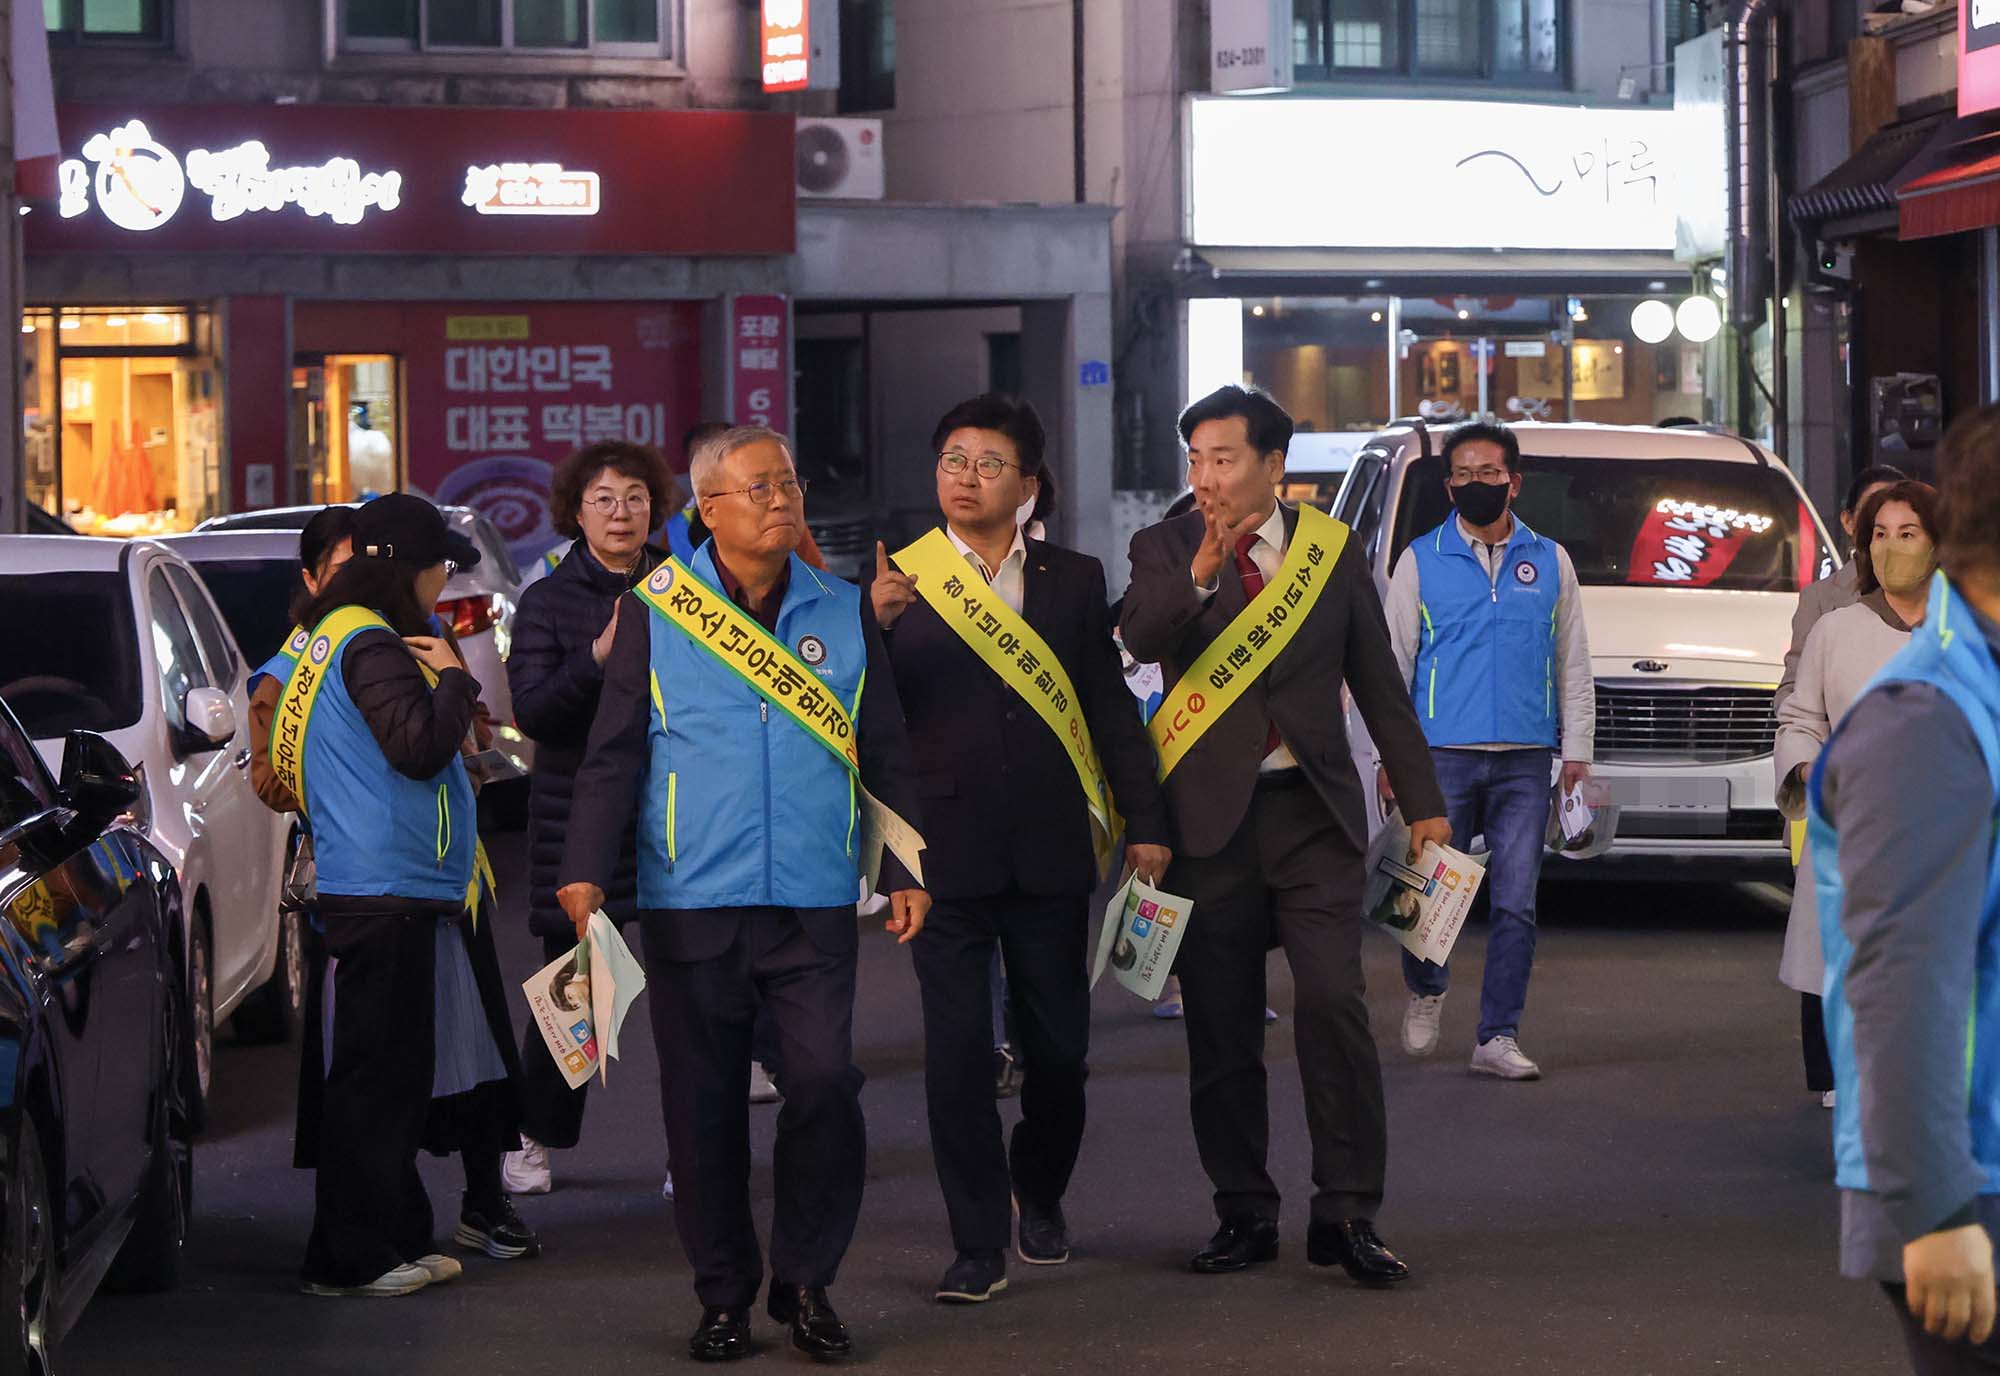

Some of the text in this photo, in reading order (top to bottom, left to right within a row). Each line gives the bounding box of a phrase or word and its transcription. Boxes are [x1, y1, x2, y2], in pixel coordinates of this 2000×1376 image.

[445, 345, 613, 392] 대한민국
[446, 403, 666, 452] 대표 떡볶이
